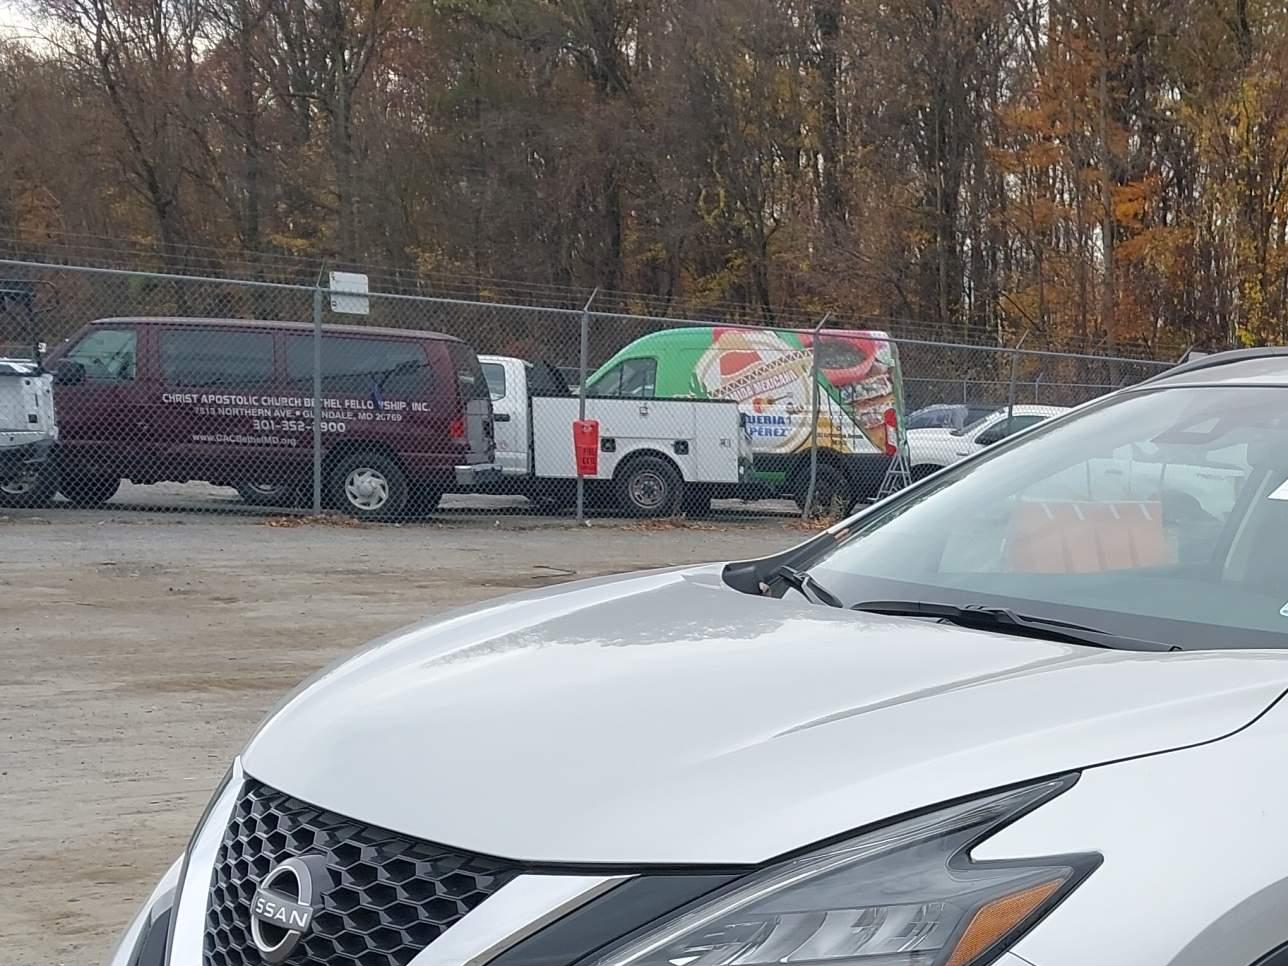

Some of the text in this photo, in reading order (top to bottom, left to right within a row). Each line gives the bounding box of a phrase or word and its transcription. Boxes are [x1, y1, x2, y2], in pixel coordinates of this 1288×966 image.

[162, 393, 198, 404] CHRIST
[201, 395, 259, 406] APOSTOLIC
[261, 397, 302, 407] CHURCH
[303, 398, 342, 409] BEHEL
[411, 402, 432, 412] INC.
[217, 407, 272, 417] NORTHERN
[302, 410, 357, 420] GLNDALE,
[358, 412, 374, 421] MD
